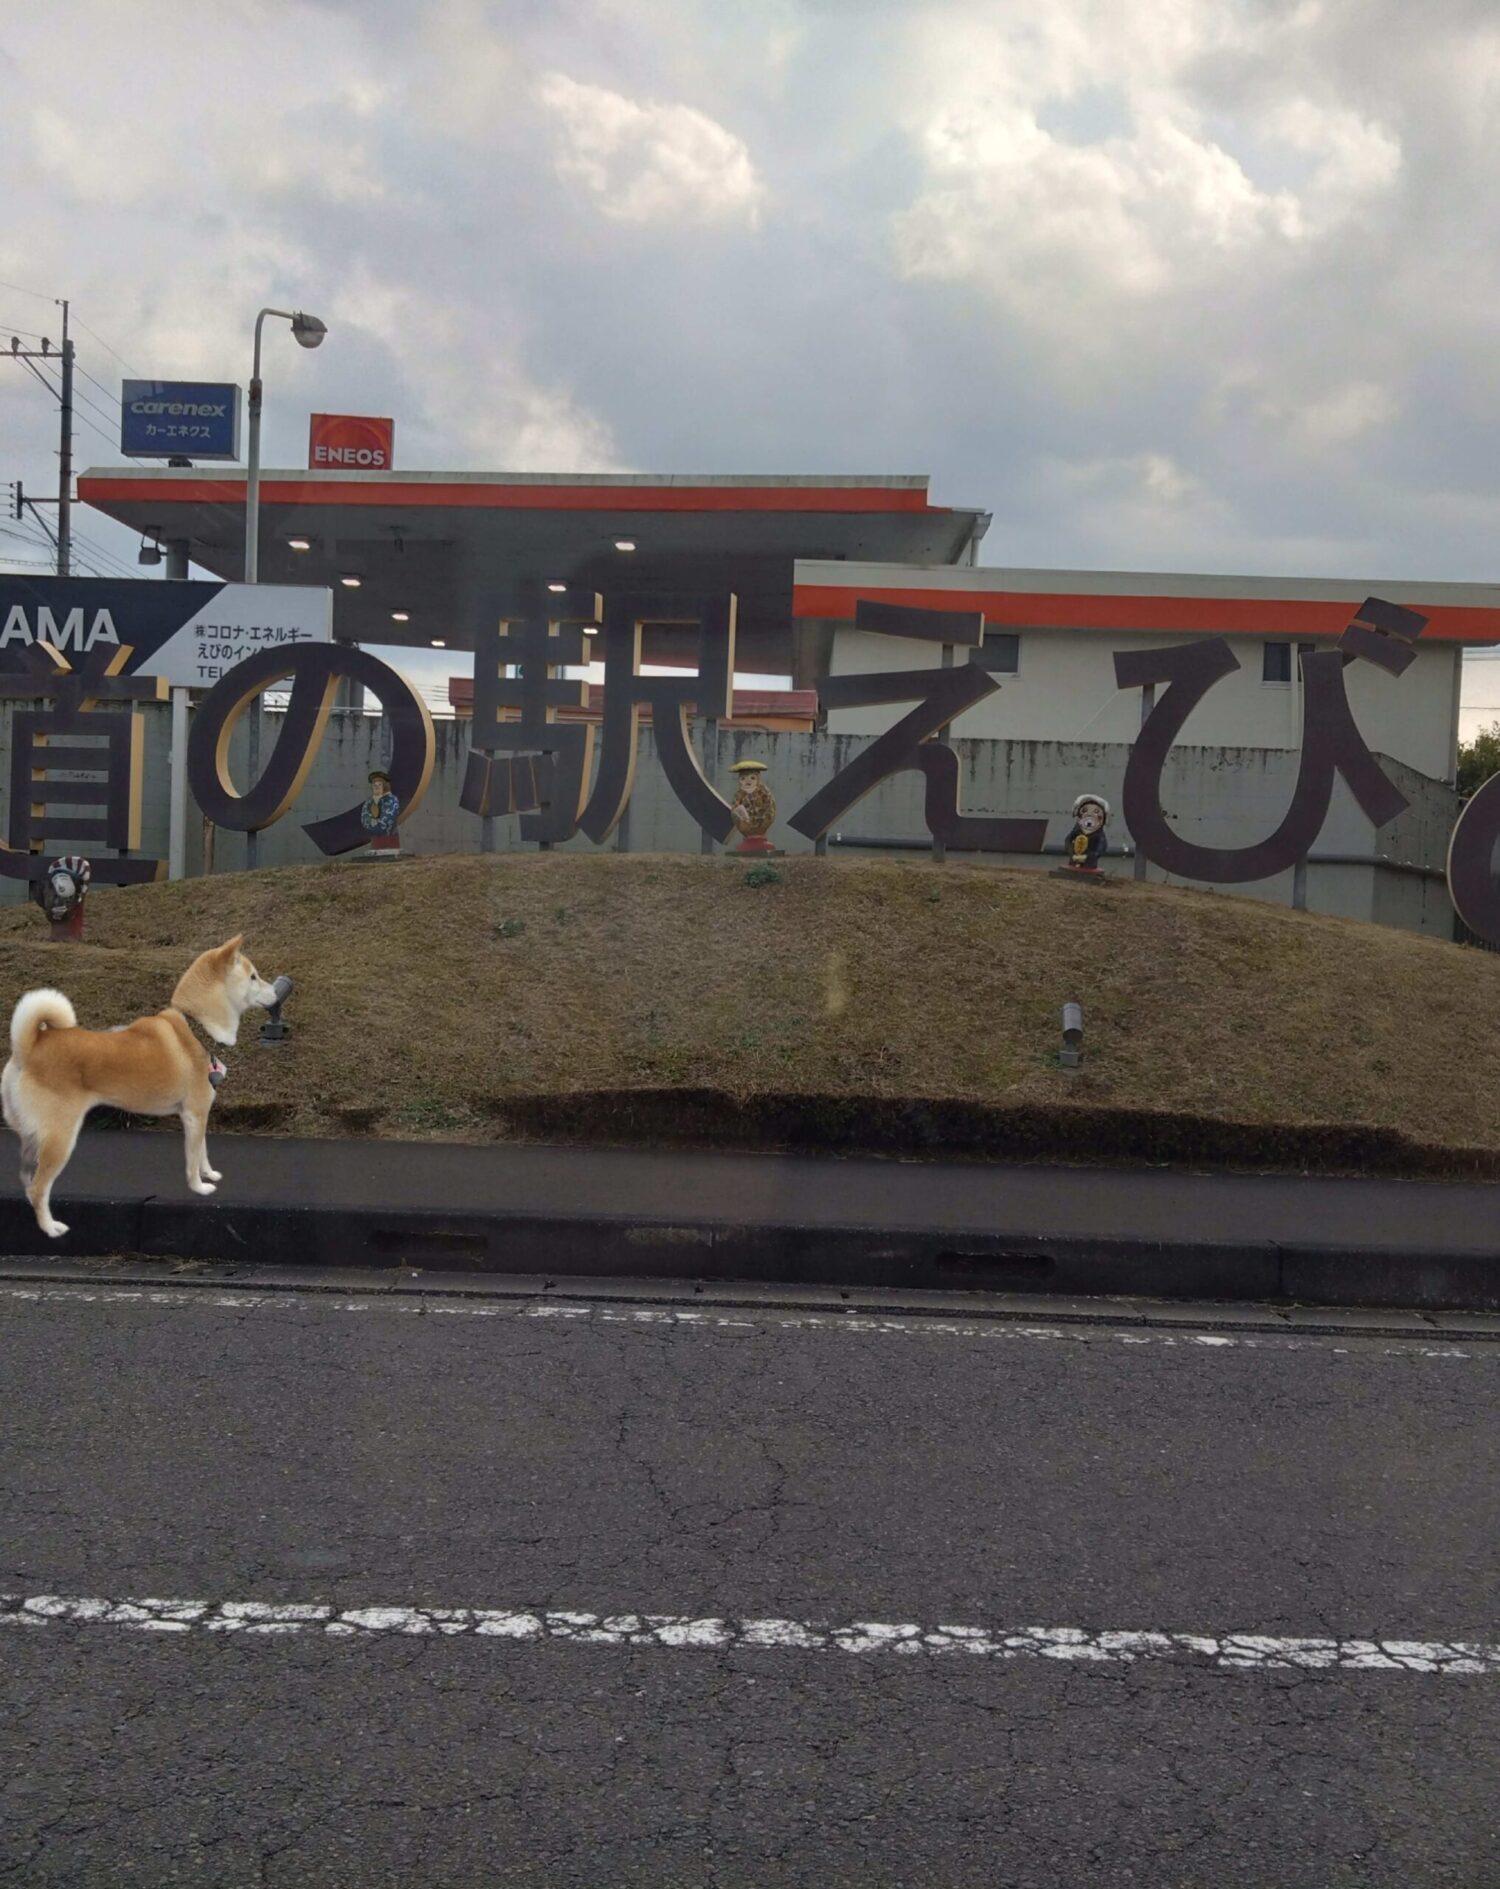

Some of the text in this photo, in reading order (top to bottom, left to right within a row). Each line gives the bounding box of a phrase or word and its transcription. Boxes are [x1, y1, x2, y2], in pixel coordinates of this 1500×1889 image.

[131, 402, 226, 417] carenex
[145, 424, 211, 438] カーエネクス
[315, 446, 385, 466] ENEOS
[0, 604, 120, 652] AMA
